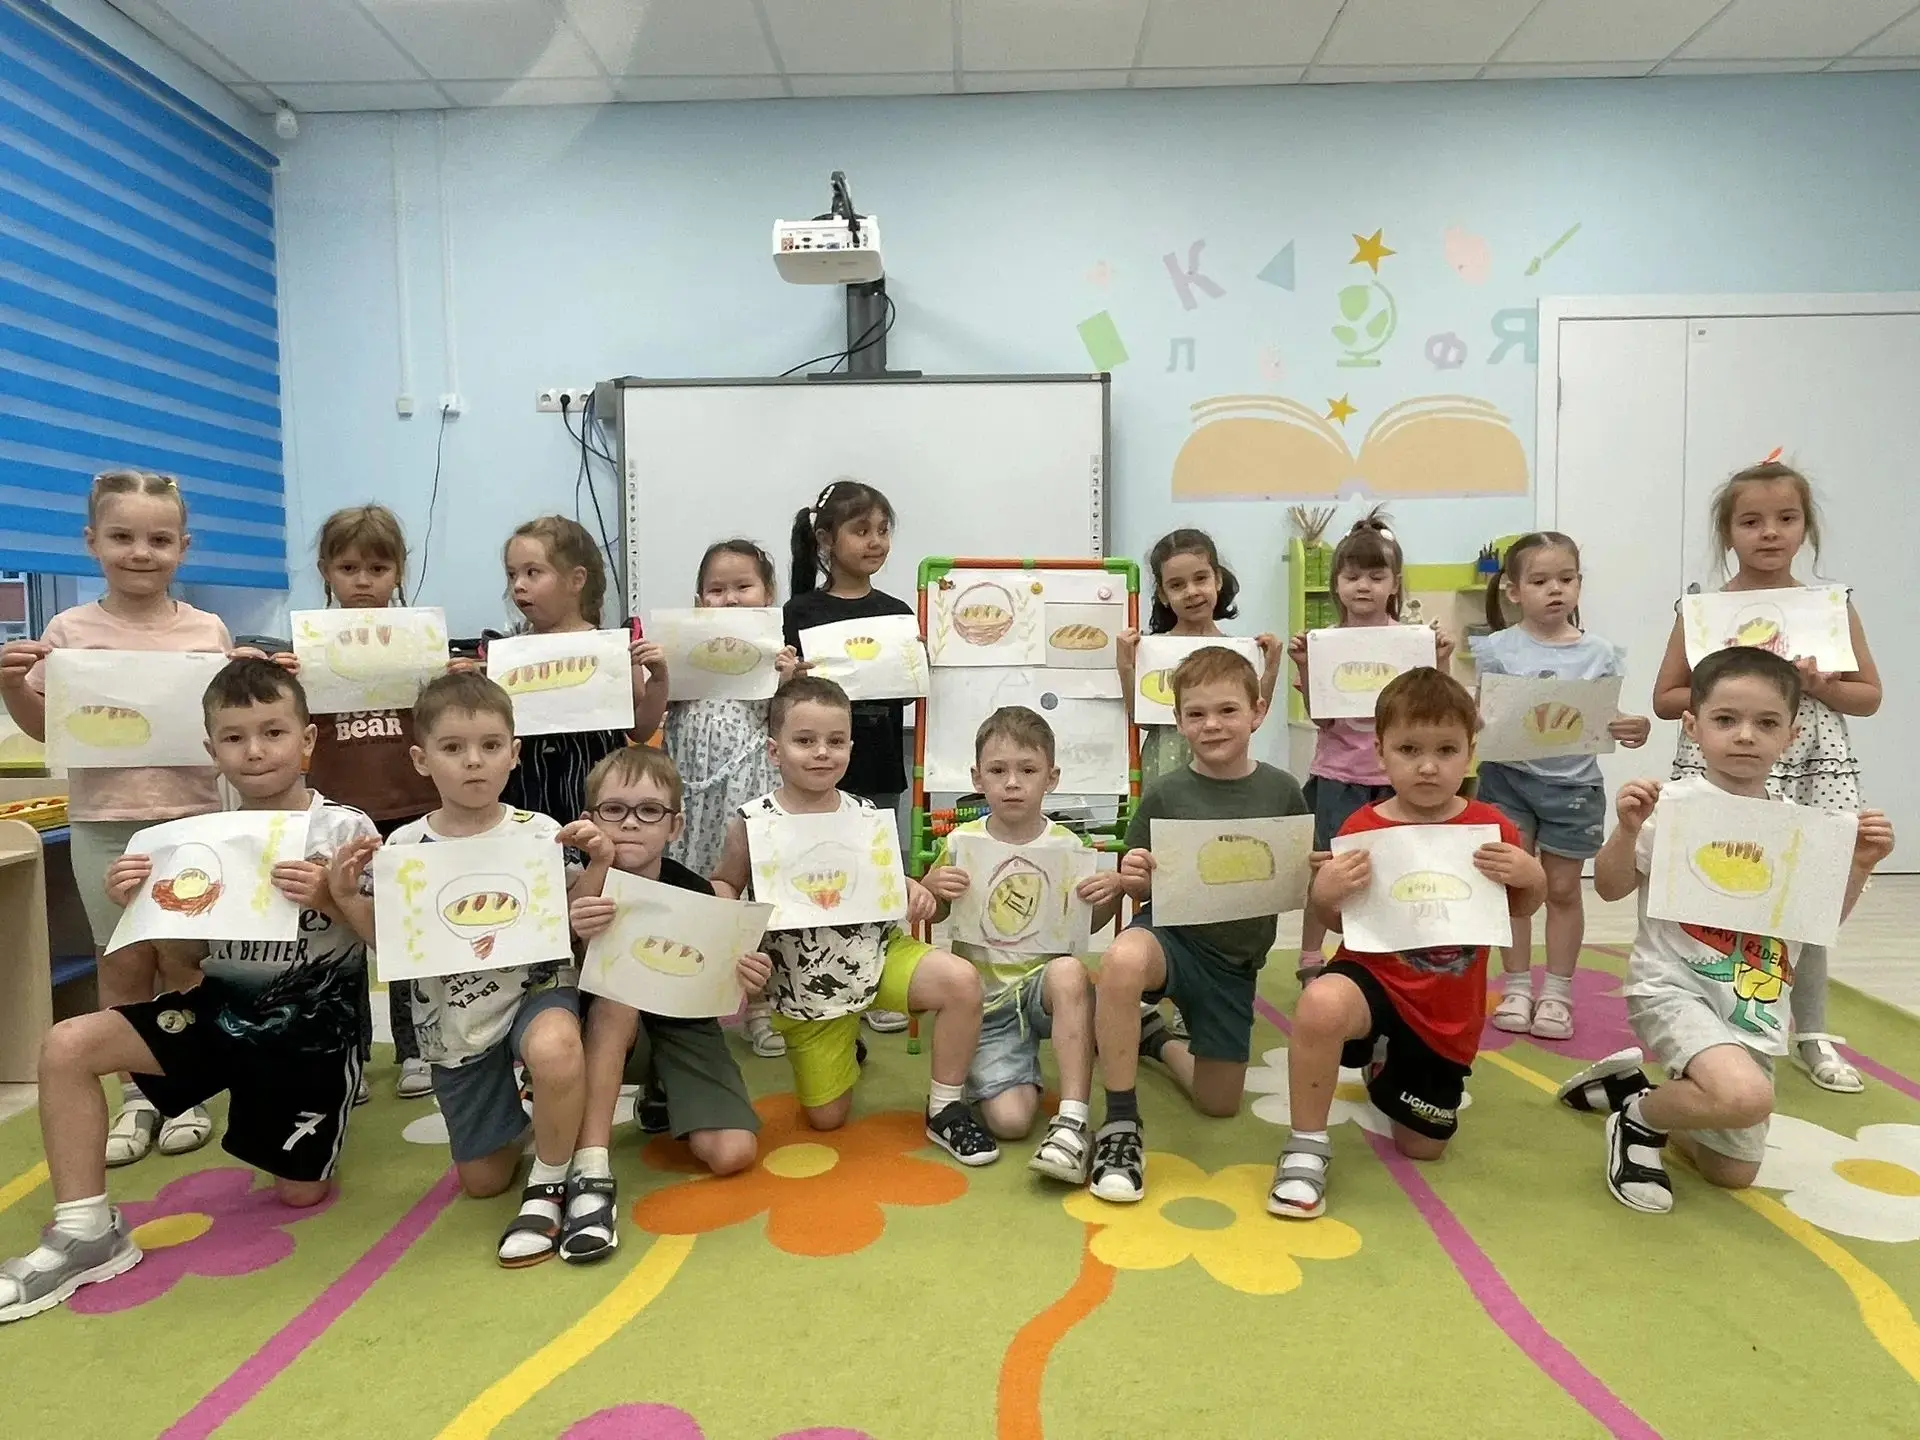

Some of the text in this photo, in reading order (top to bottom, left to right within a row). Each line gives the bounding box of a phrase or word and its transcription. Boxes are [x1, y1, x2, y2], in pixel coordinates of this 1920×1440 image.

[1486, 308, 1538, 364] Я
[240, 938, 308, 962] BETTER
[451, 975, 482, 996] THE
[283, 1111, 327, 1151] 7
